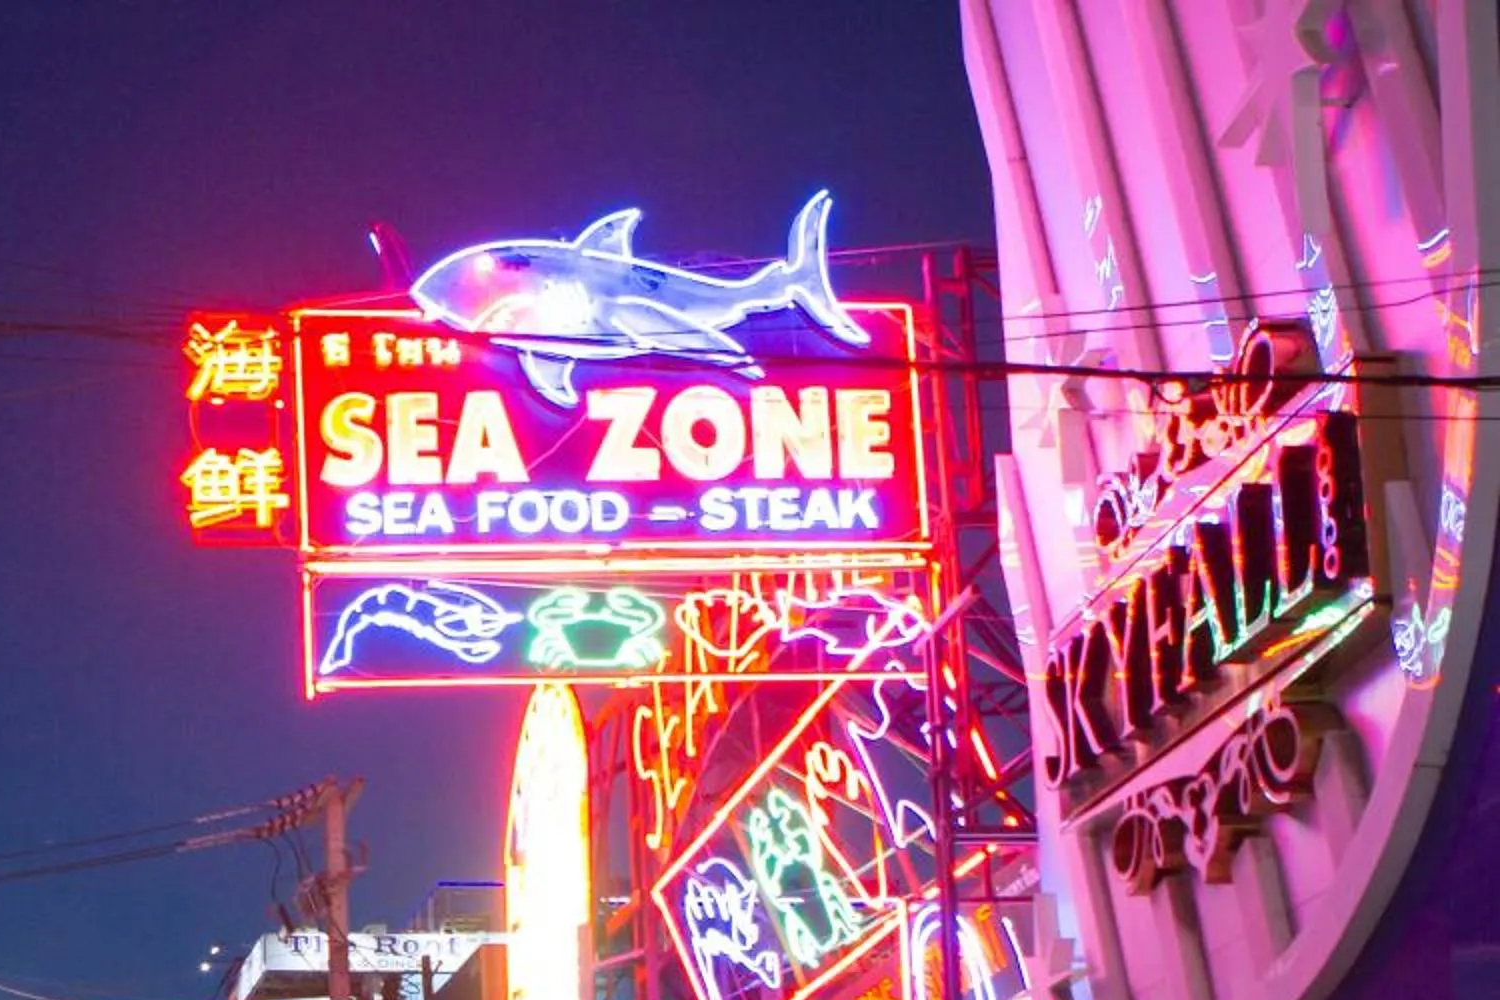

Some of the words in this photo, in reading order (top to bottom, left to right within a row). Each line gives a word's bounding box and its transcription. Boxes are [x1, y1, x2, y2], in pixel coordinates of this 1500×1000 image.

[319, 388, 530, 486] SEA
[586, 385, 896, 483] ZONE
[346, 492, 453, 536] SEA
[477, 490, 629, 534] FOOD
[700, 486, 880, 532] STEAK
[1042, 440, 1320, 792] SKYFALL
